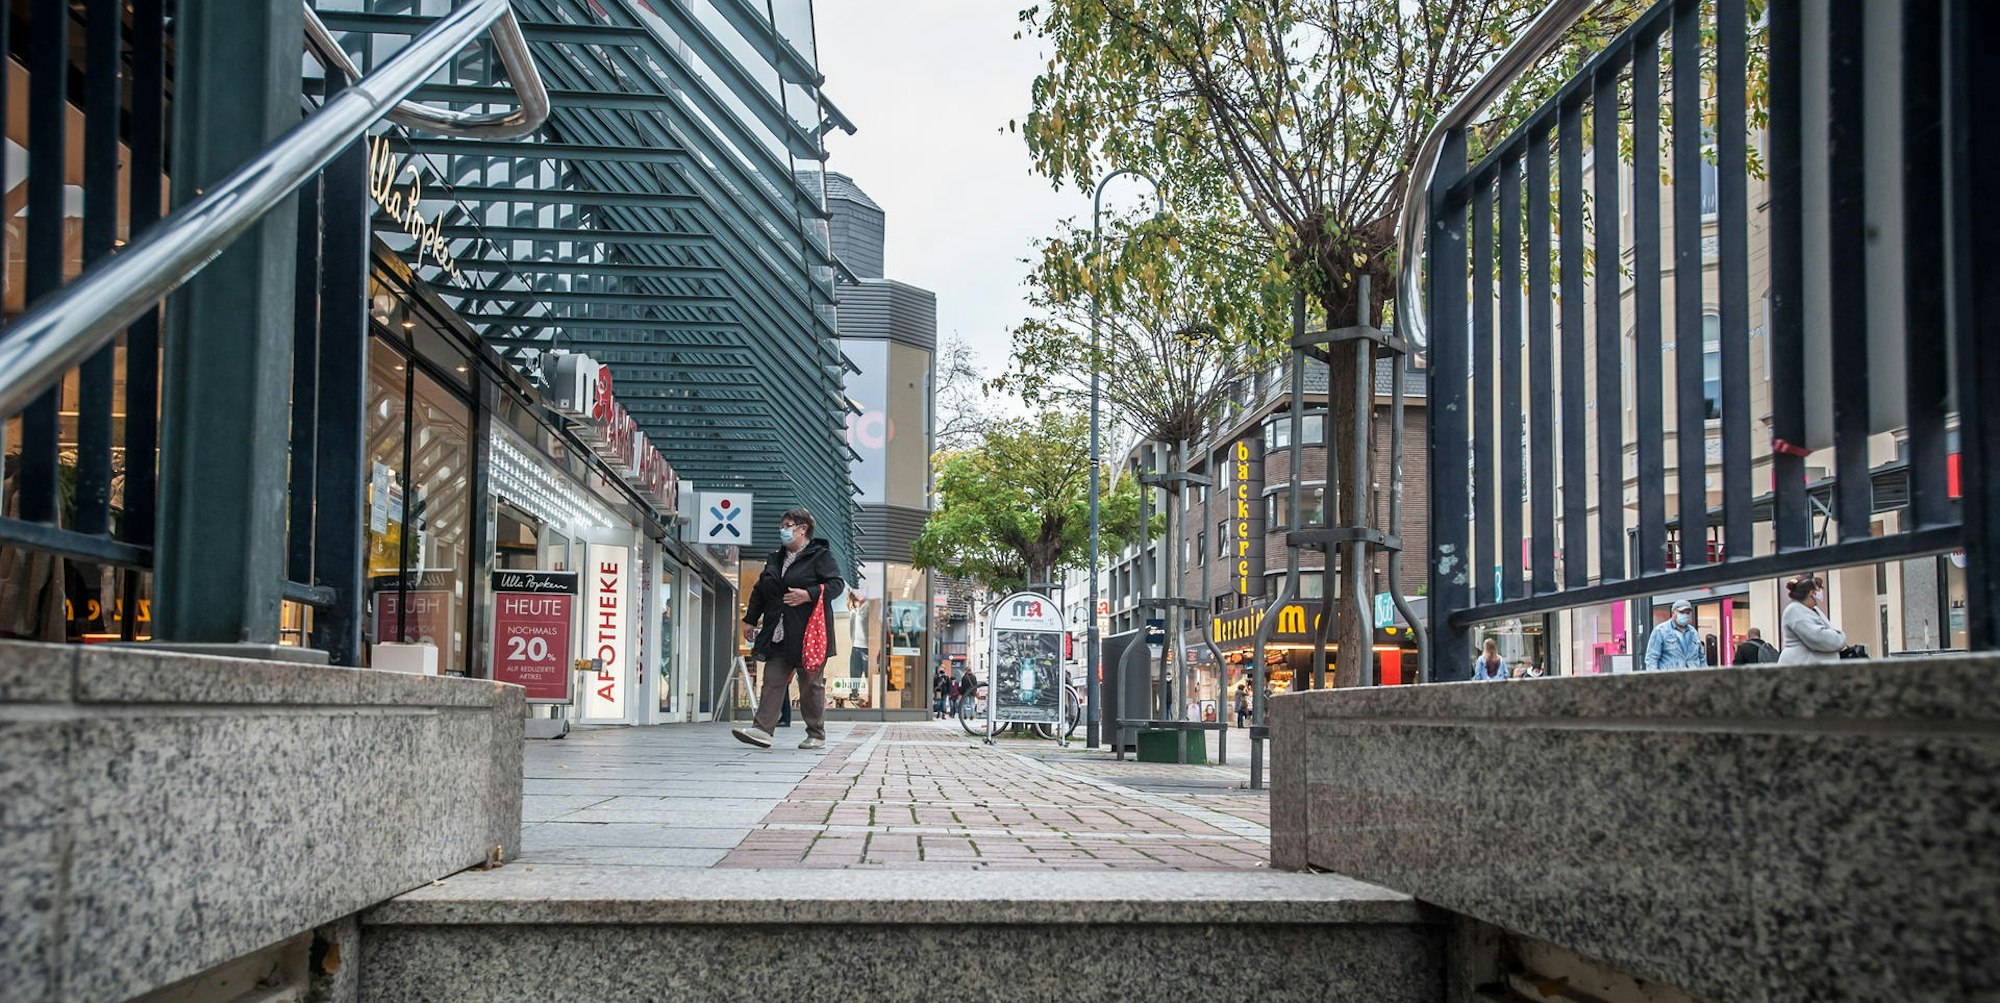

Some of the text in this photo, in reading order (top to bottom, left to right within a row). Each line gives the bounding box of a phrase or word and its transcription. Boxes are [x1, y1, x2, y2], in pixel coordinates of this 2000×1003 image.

[501, 573, 568, 592] Ulla Popken
[505, 599, 562, 616] HEUTE
[507, 626, 557, 635] NOCHMALS
[507, 636, 557, 662] 20%
